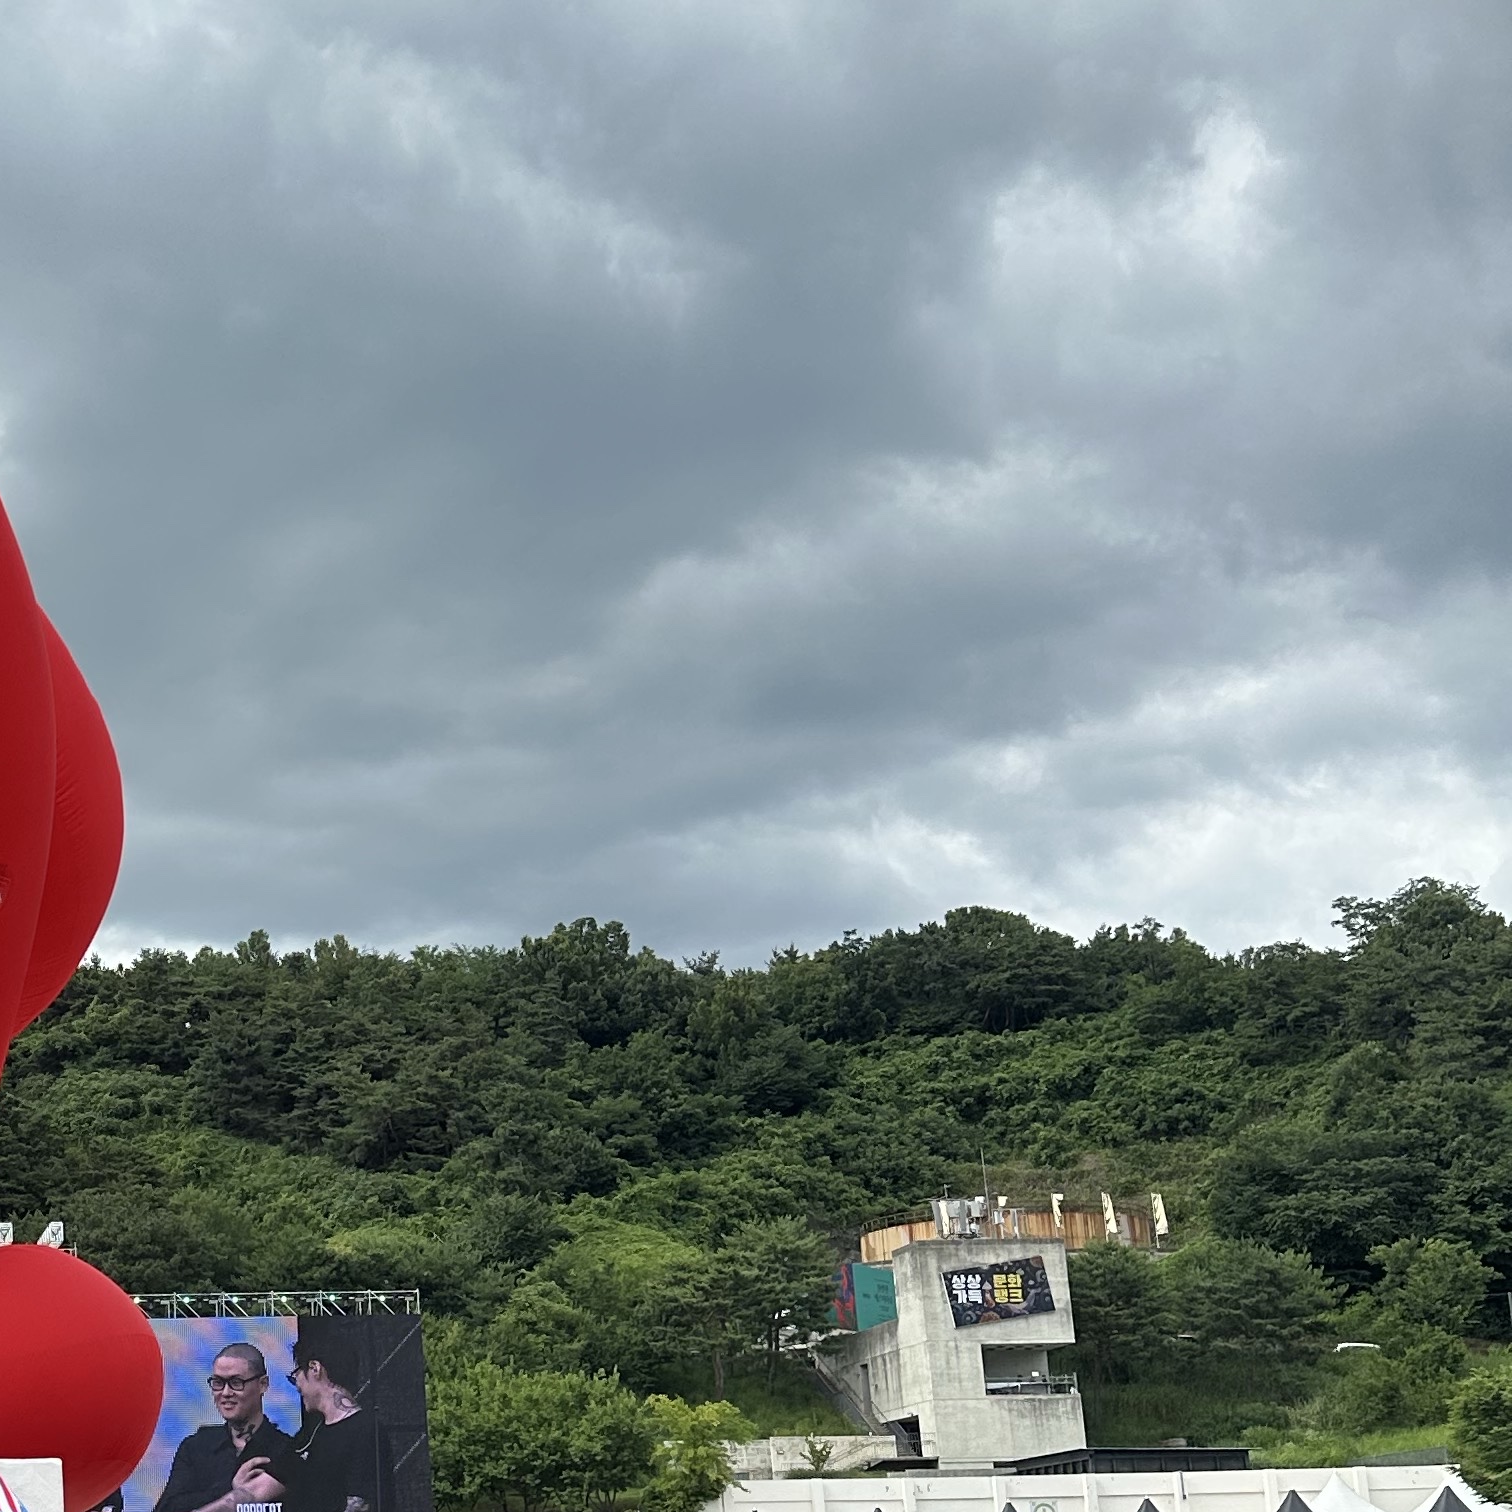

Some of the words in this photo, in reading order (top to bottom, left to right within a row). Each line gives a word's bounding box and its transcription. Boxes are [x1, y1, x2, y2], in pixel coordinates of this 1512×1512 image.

[951, 1274, 982, 1289] 상상
[992, 1273, 1023, 1289] 문화
[952, 1289, 983, 1304] 가득
[994, 1288, 1024, 1304] 탱크
